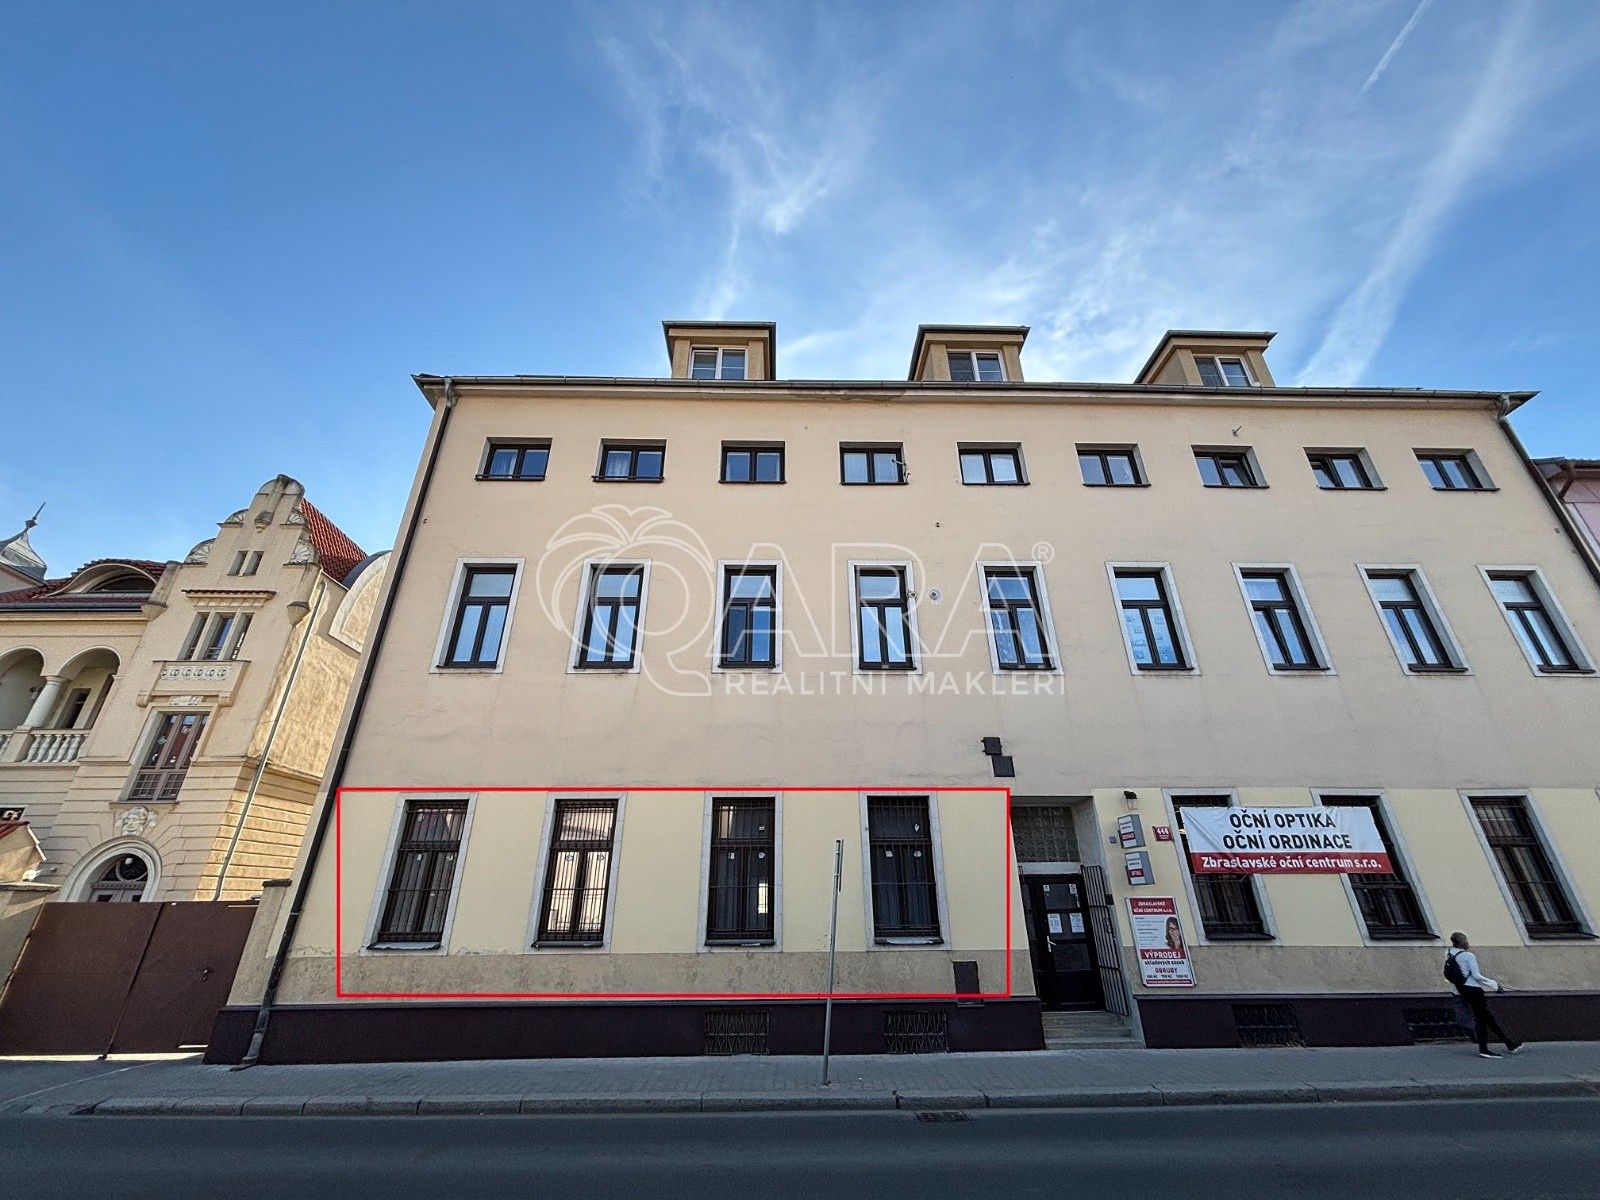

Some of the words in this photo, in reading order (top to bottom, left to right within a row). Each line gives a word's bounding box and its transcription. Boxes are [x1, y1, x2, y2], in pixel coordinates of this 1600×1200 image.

[1229, 809, 1271, 828] OČNÍ
[1274, 813, 1336, 828] OPTIKA
[1223, 829, 1265, 849] OČNÍ
[1268, 834, 1352, 849] ORDINACE
[1201, 856, 1277, 868] Zbraslavské
[1279, 855, 1304, 868] oční
[1305, 857, 1354, 868] centrum
[1354, 859, 1382, 868] s.r.o.
[1144, 950, 1181, 959] VÝPRODEJ
